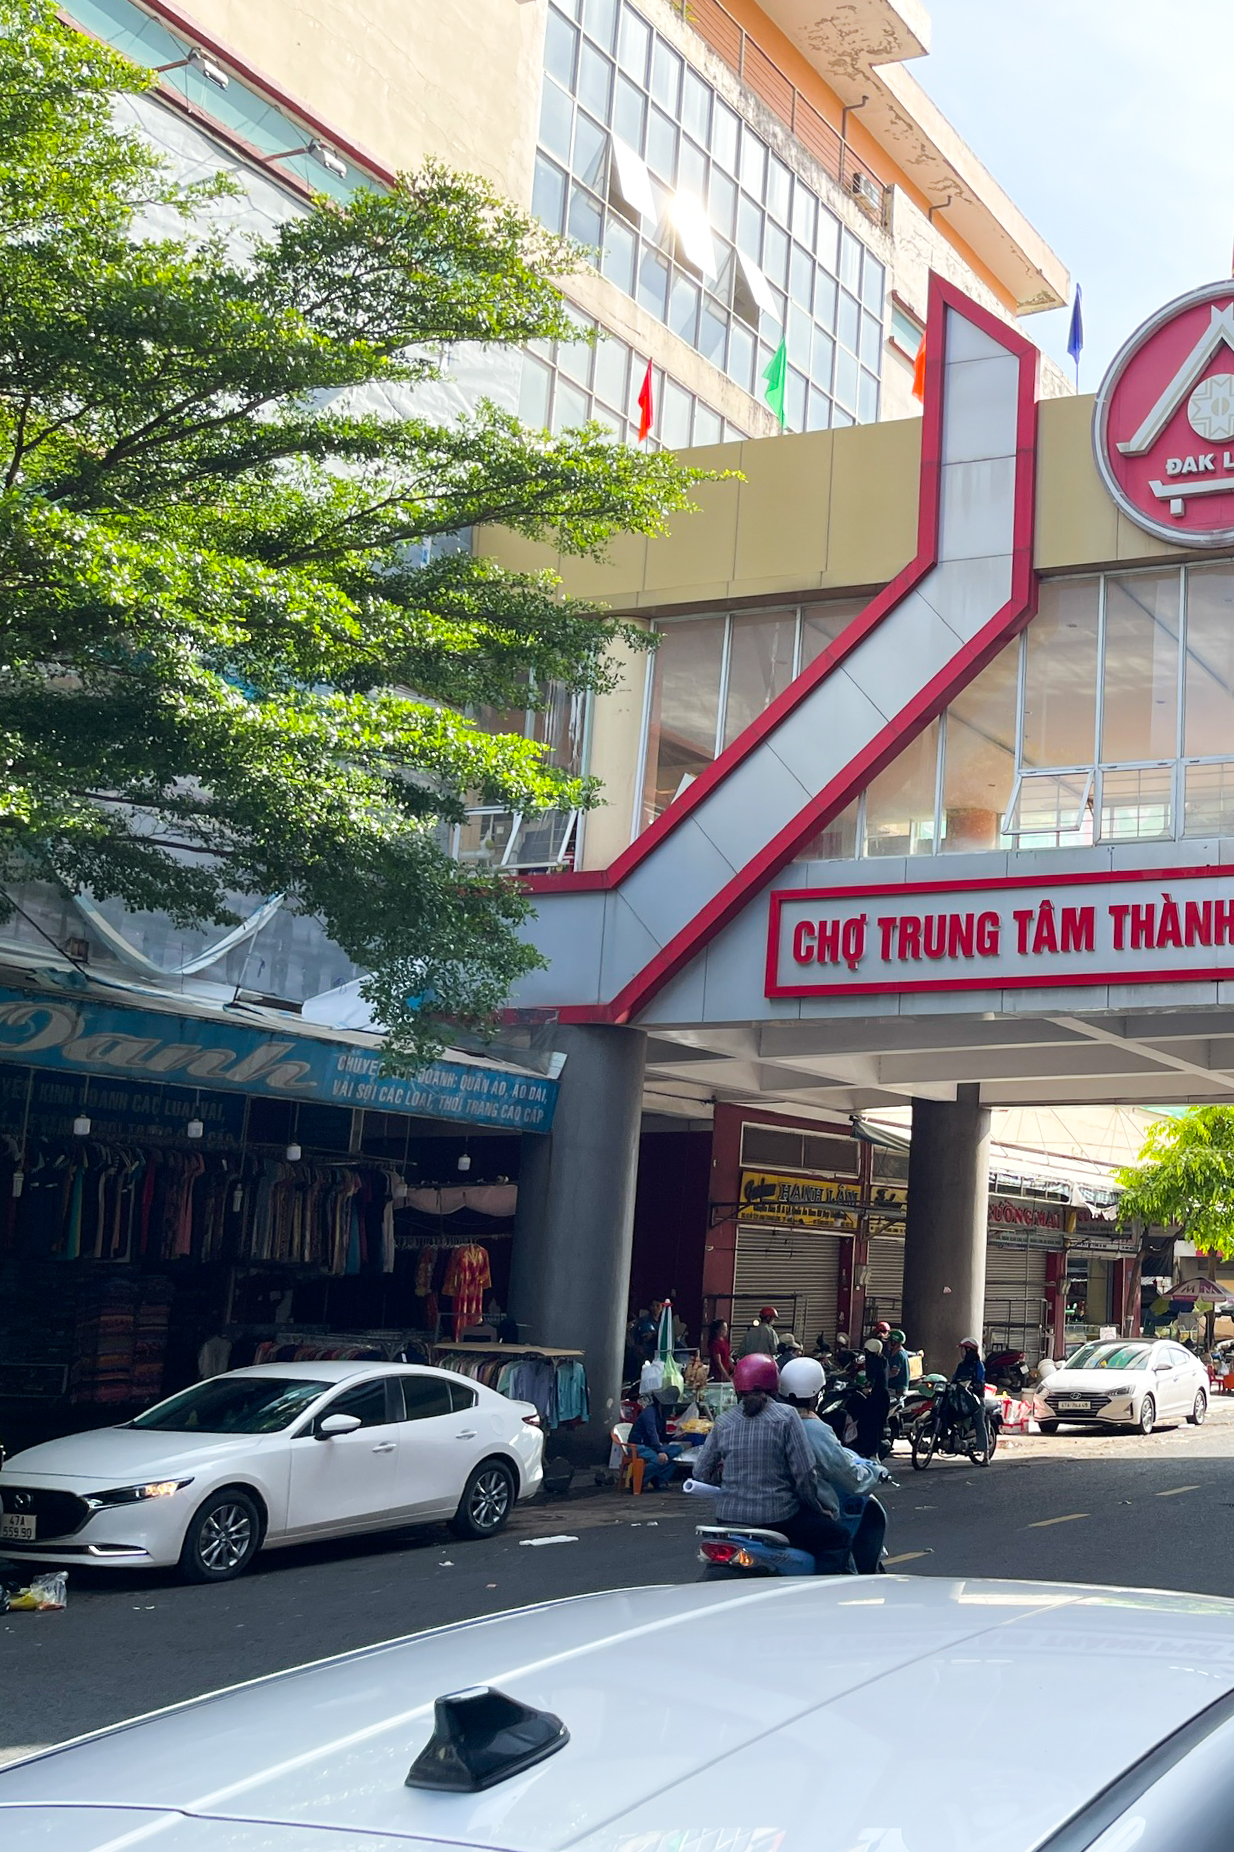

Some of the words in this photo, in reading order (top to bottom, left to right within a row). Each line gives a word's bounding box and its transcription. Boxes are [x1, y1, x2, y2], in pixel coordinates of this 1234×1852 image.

[792, 913, 867, 970] CHỢ
[877, 910, 1001, 961] TRUNG
[1012, 899, 1096, 955] TÂM
[379, 1084, 403, 1105] CÁC
[466, 1098, 499, 1117] TRANG
[501, 1104, 521, 1121] CAO
